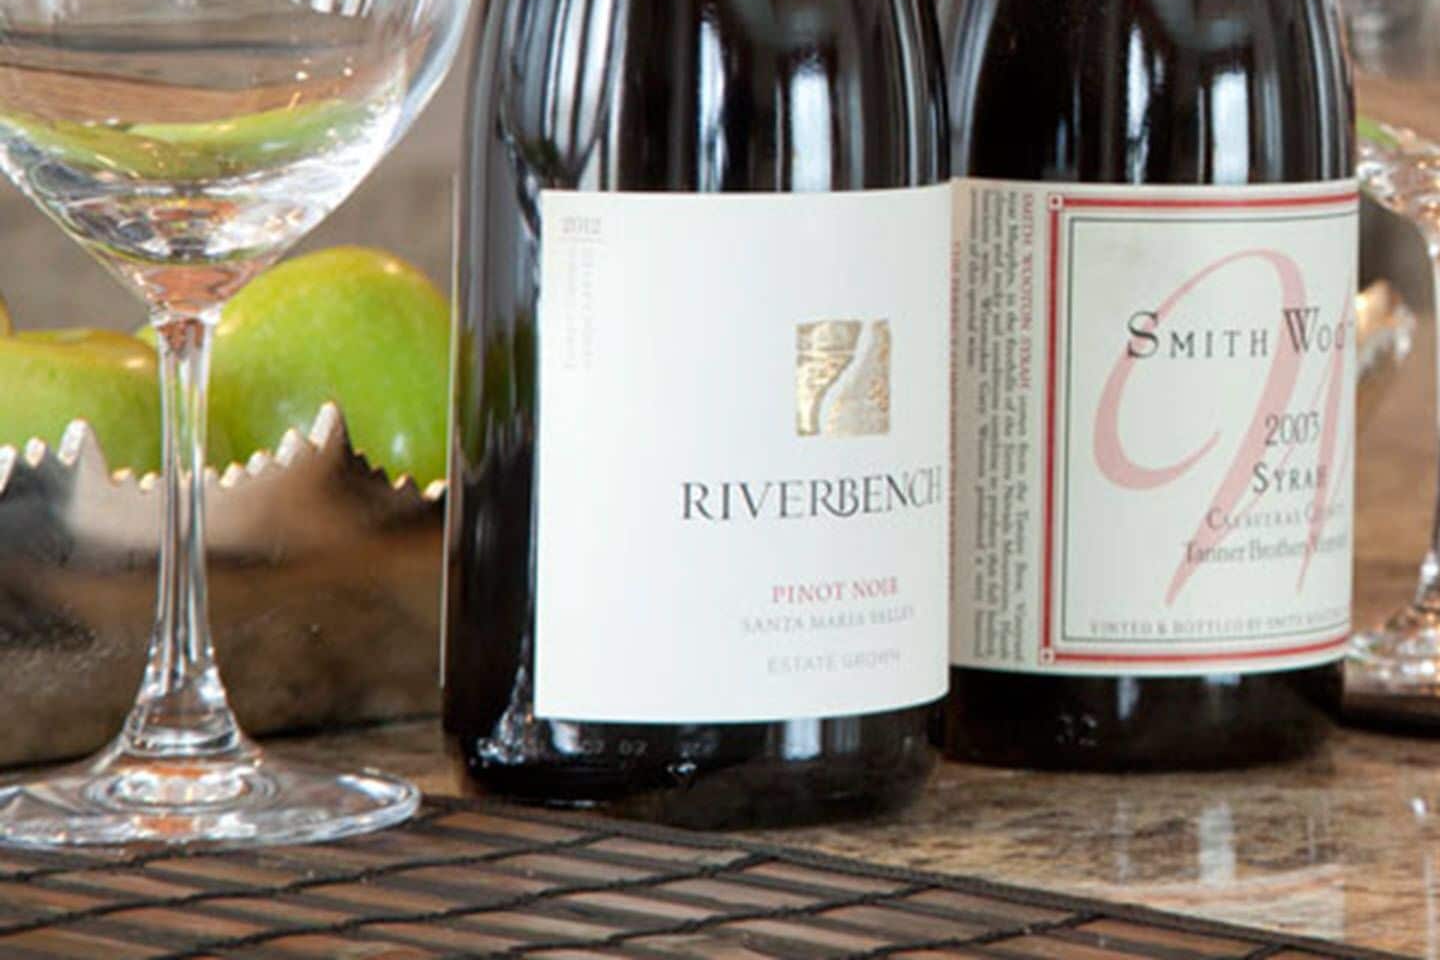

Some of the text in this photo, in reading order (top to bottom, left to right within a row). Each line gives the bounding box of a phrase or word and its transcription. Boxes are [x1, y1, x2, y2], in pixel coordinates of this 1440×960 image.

[1126, 309, 1269, 359] SMITH
[1264, 410, 1320, 447] 2003
[682, 465, 942, 521] RIVERBENCH
[771, 575, 899, 604] PINOT NOIR
[740, 614, 804, 634] SANTA
[810, 610, 866, 630] MARIA
[766, 654, 835, 674] ESTATE
